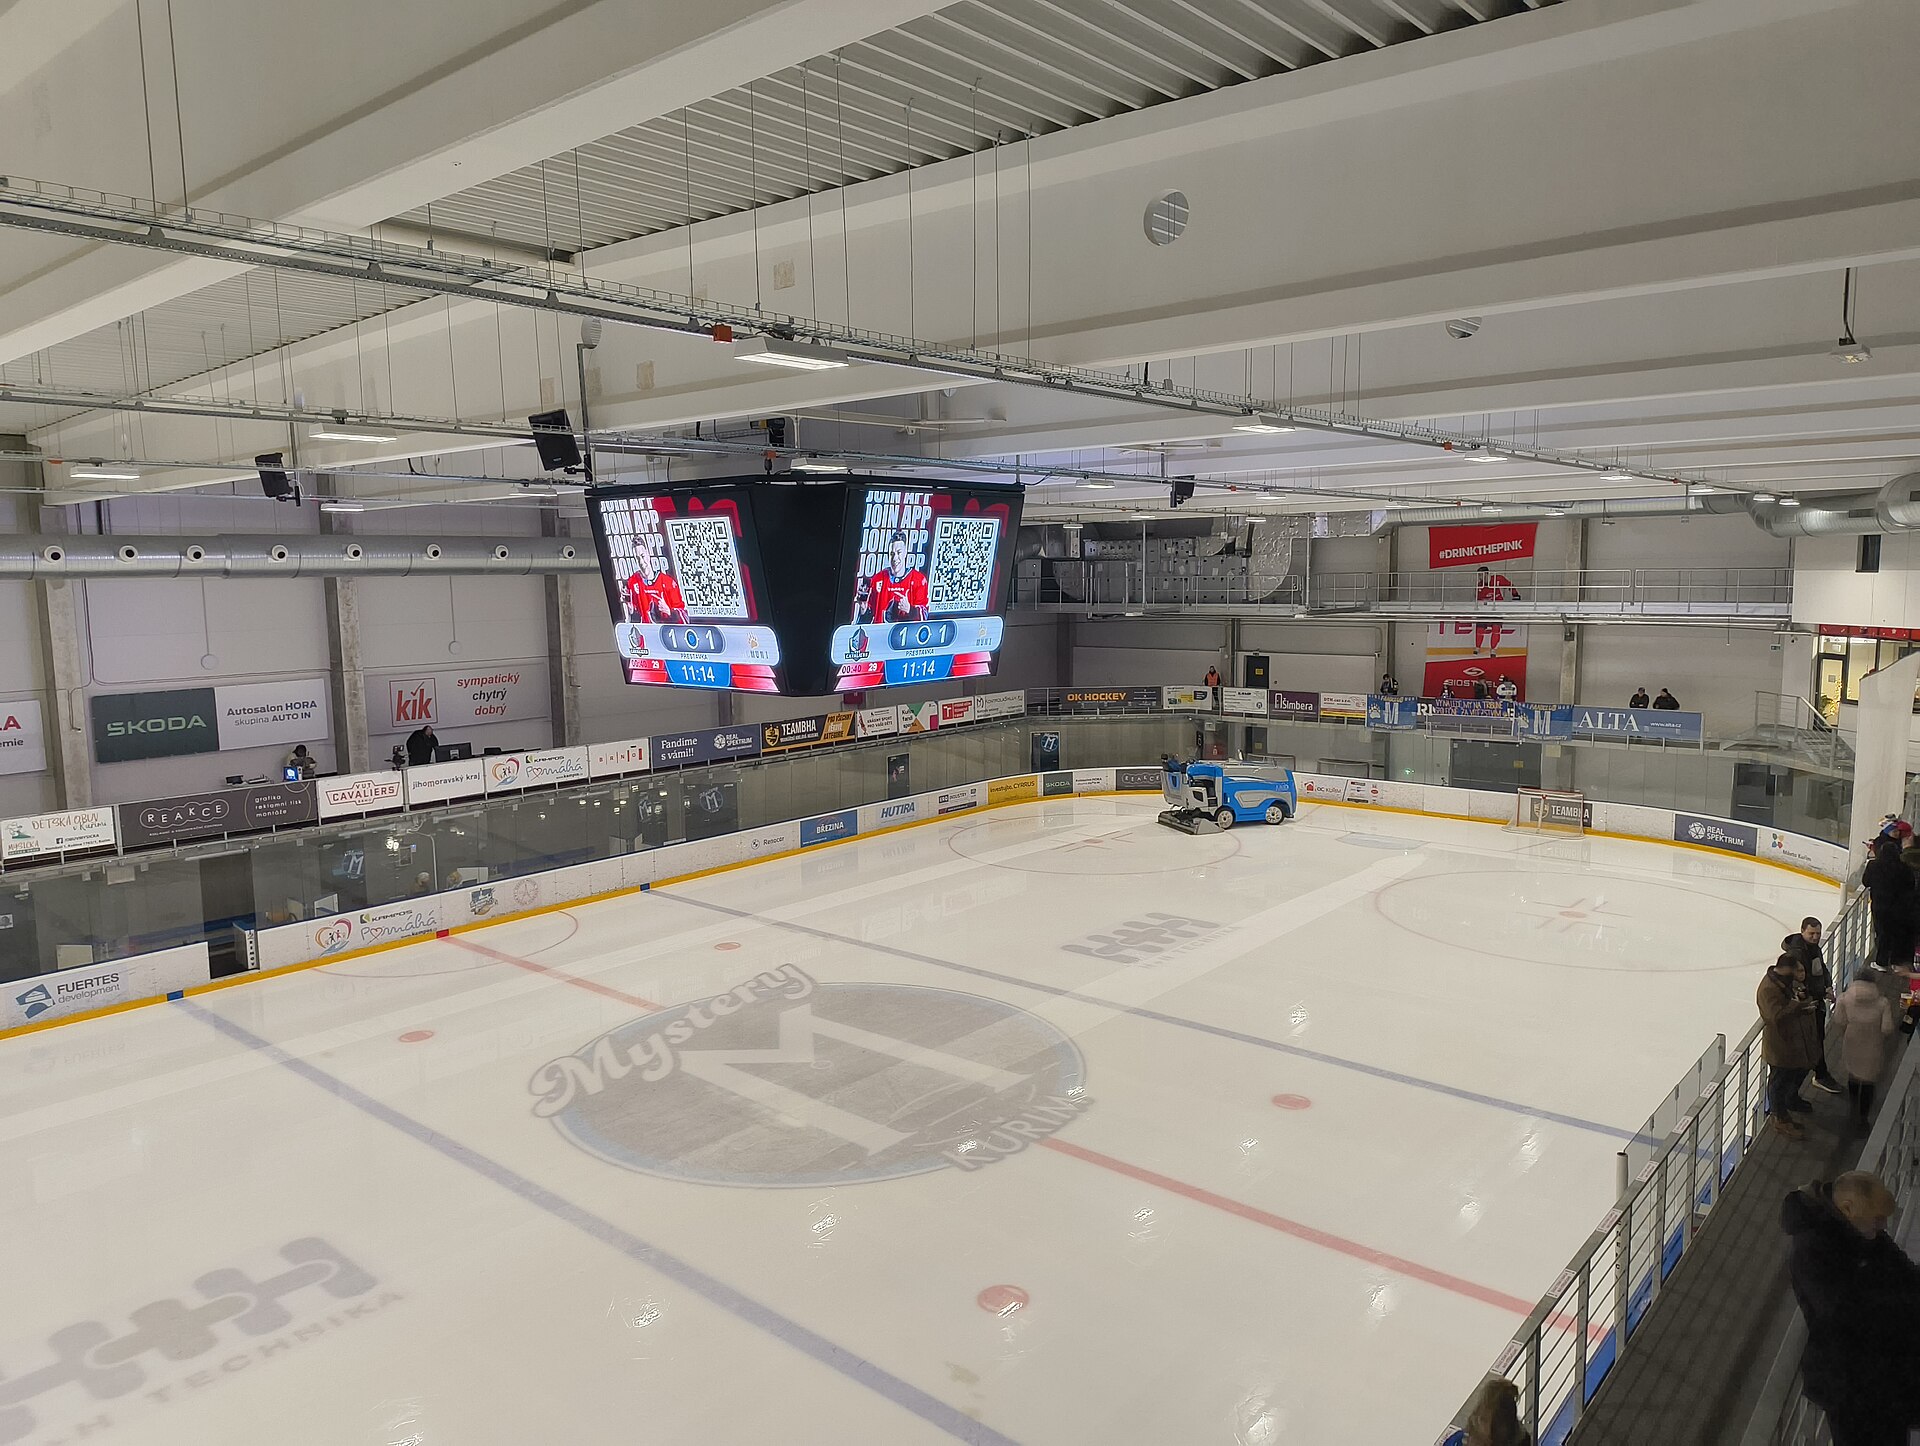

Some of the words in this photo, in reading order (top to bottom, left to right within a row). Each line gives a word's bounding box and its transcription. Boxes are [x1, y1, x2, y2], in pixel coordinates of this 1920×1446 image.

[603, 511, 633, 535] JOIN
[634, 509, 660, 533] APP
[863, 504, 899, 527] JOIN
[901, 506, 932, 528] APP
[1439, 539, 1523, 560] #DRINKTHEPINK
[668, 628, 678, 648] 1
[706, 629, 715, 650] 1
[899, 627, 908, 647] 1
[939, 624, 947, 644] 1
[682, 665, 715, 682] 11:14
[841, 665, 862, 674] 00:40
[902, 660, 935, 678] 11:14
[457, 672, 520, 688] sympatický
[396, 682, 432, 721] kik
[473, 688, 507, 702] chytrý
[1067, 693, 1082, 701] OK
[1084, 692, 1127, 701] HOCKEY
[226, 704, 283, 717] Autosalon
[285, 700, 318, 711] HORA
[475, 703, 507, 716] dobrý
[1282, 697, 1313, 711] Šimbera
[234, 715, 270, 727] skupina
[271, 713, 299, 722] AUTO
[300, 712, 311, 720] IN
[1578, 711, 1639, 732] ALTA
[781, 719, 817, 736] TEAMBHA
[661, 737, 698, 749] Fandíme
[727, 737, 753, 746] SPEKTRUM
[668, 748, 694, 759] vámi!!
[355, 782, 371, 790] VUT
[412, 775, 464, 790] jihomoravský
[466, 773, 481, 782] kraj
[1013, 780, 1035, 789] CYRRUS
[254, 794, 281, 803] grafika
[332, 786, 395, 802] CAVALIERS
[147, 804, 223, 823] REAKCE
[255, 802, 287, 810] reklamní
[256, 809, 287, 818] montáže
[881, 802, 915, 818] HUTIRA
[74, 812, 99, 824] OBUV
[816, 821, 845, 834] BŘEZINA
[1707, 825, 1725, 836] REAL
[763, 836, 785, 846] Renocar
[1706, 834, 1745, 847] SPEKTRUM
[372, 909, 413, 922] KAMPOS
[57, 972, 120, 995] FUERTES
[58, 984, 120, 1004] development
[530, 962, 819, 1117] Mystery
